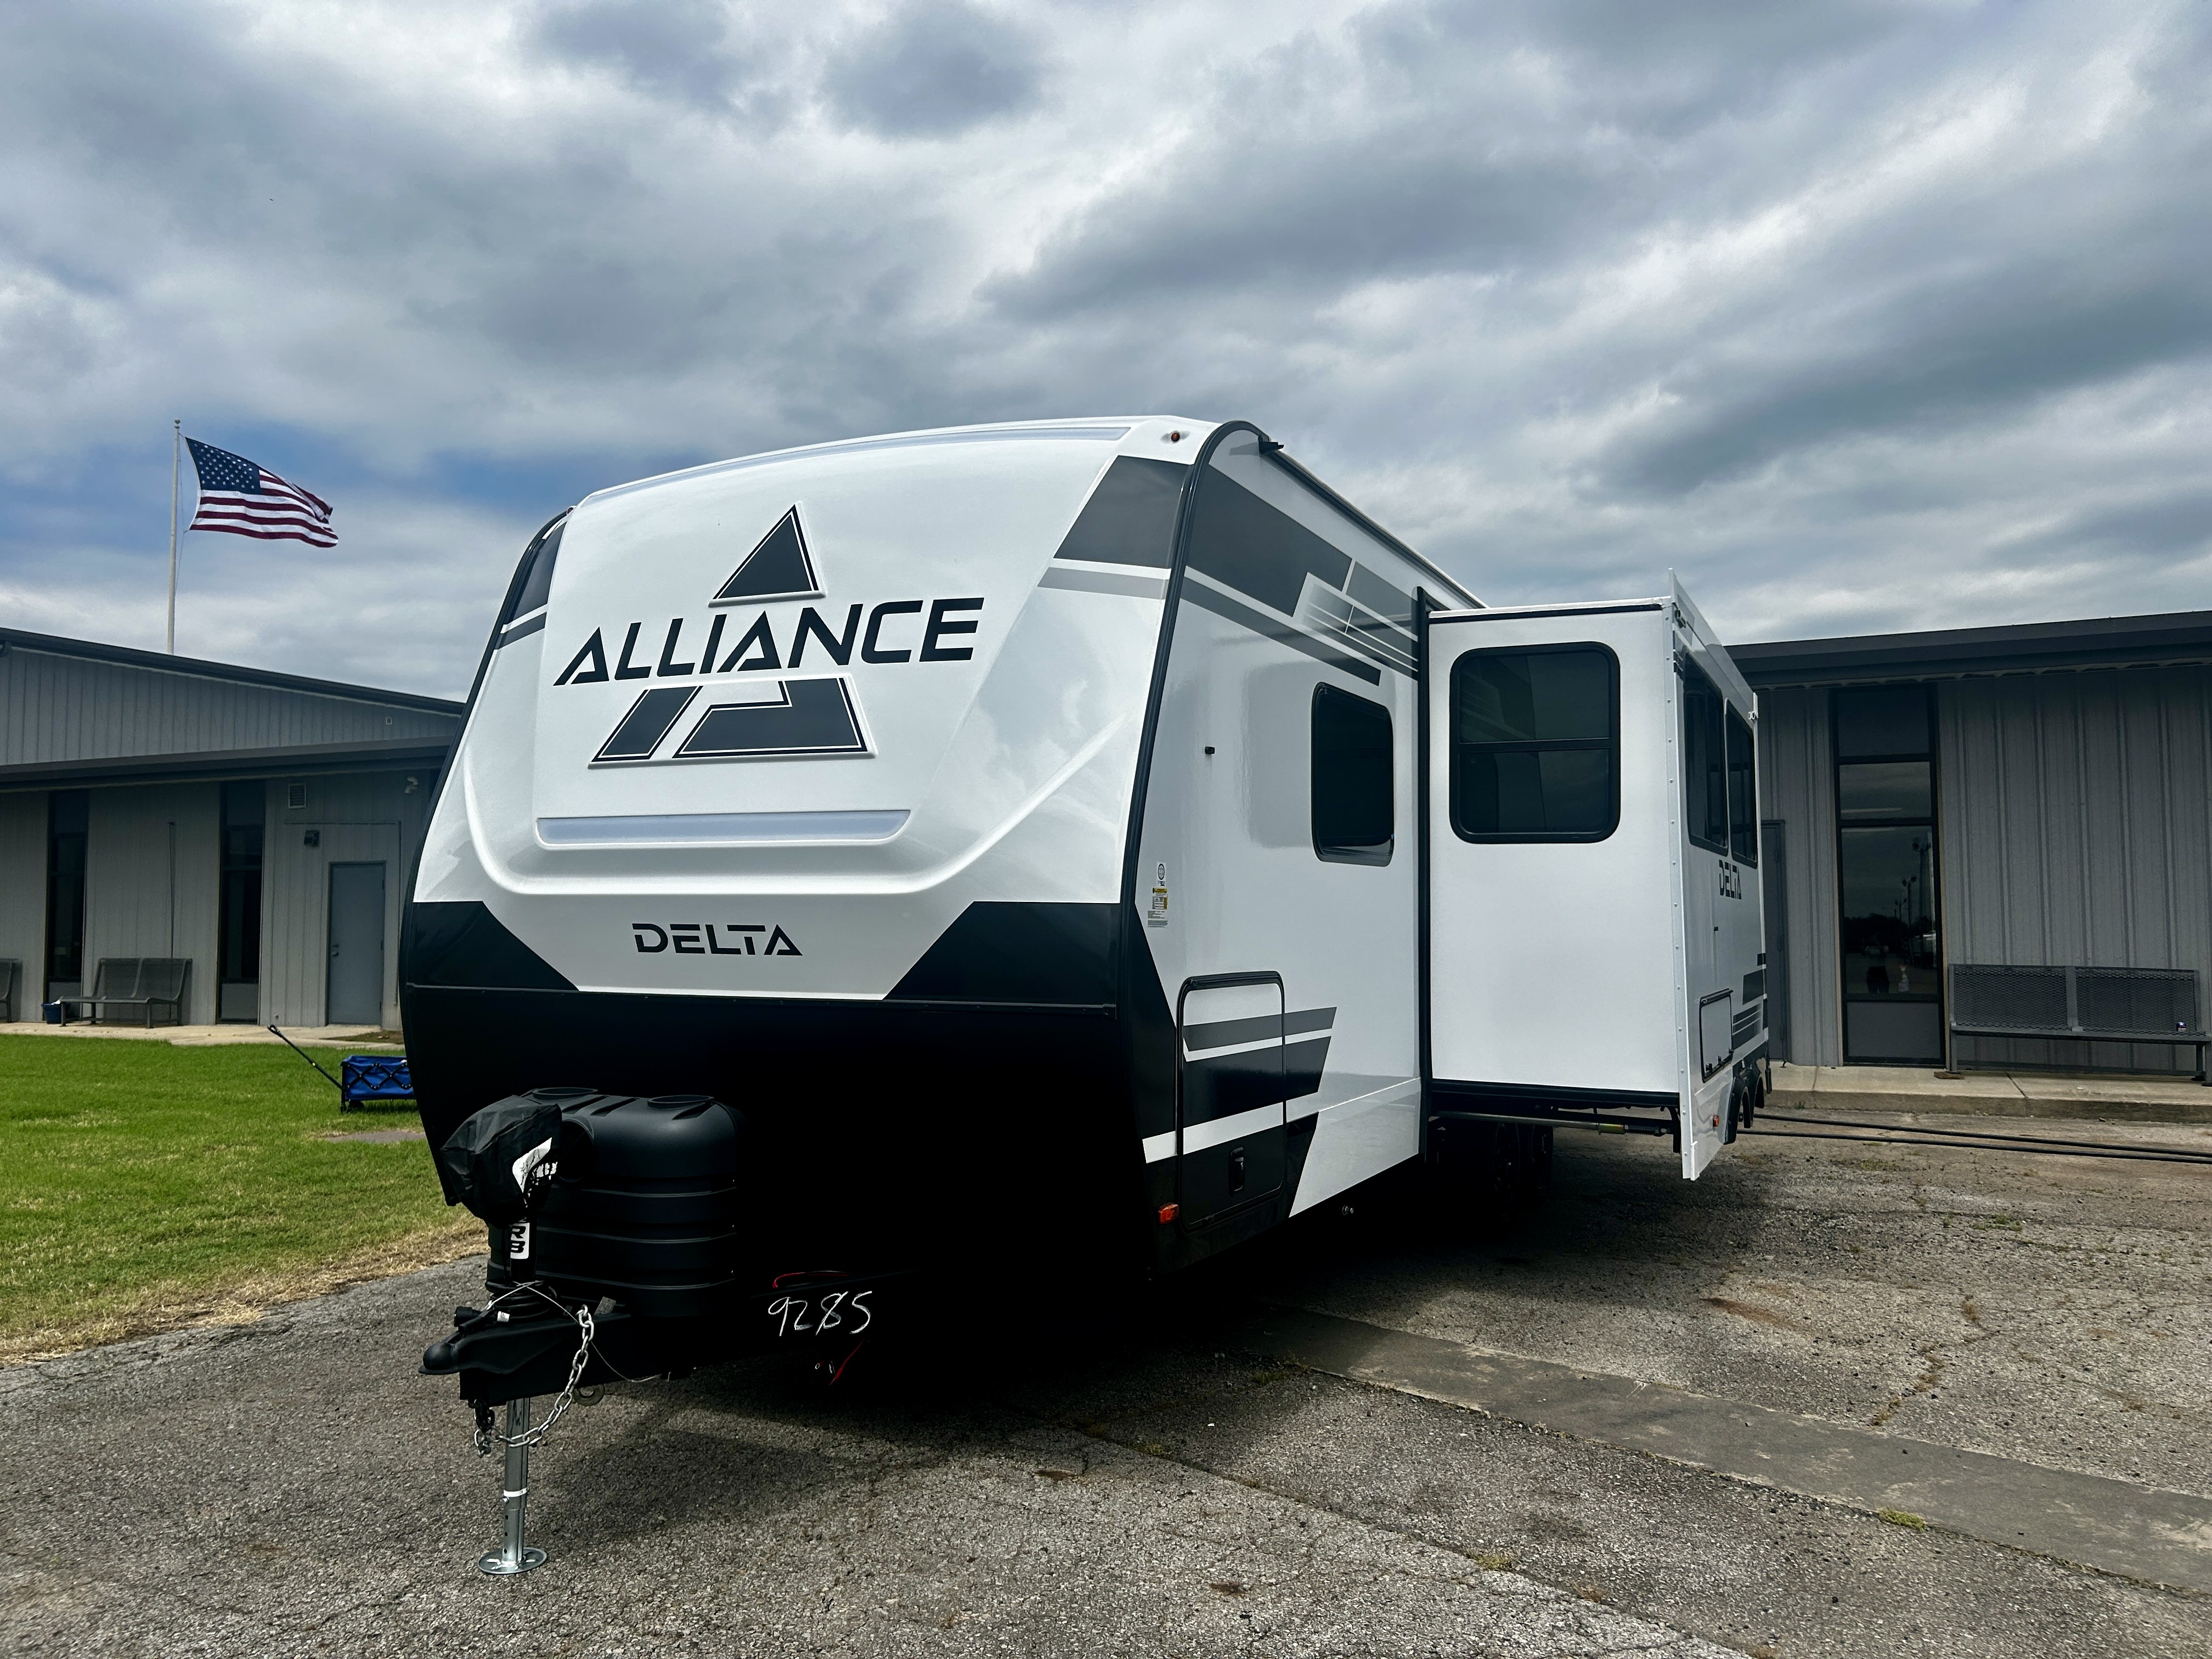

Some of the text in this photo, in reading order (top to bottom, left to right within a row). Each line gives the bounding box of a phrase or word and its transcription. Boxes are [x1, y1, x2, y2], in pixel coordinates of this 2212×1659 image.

[553, 597, 985, 686] ALLIANCE
[1718, 859, 1742, 900] DELTA
[631, 923, 803, 956] DELTA
[768, 1290, 873, 1336] 9285
